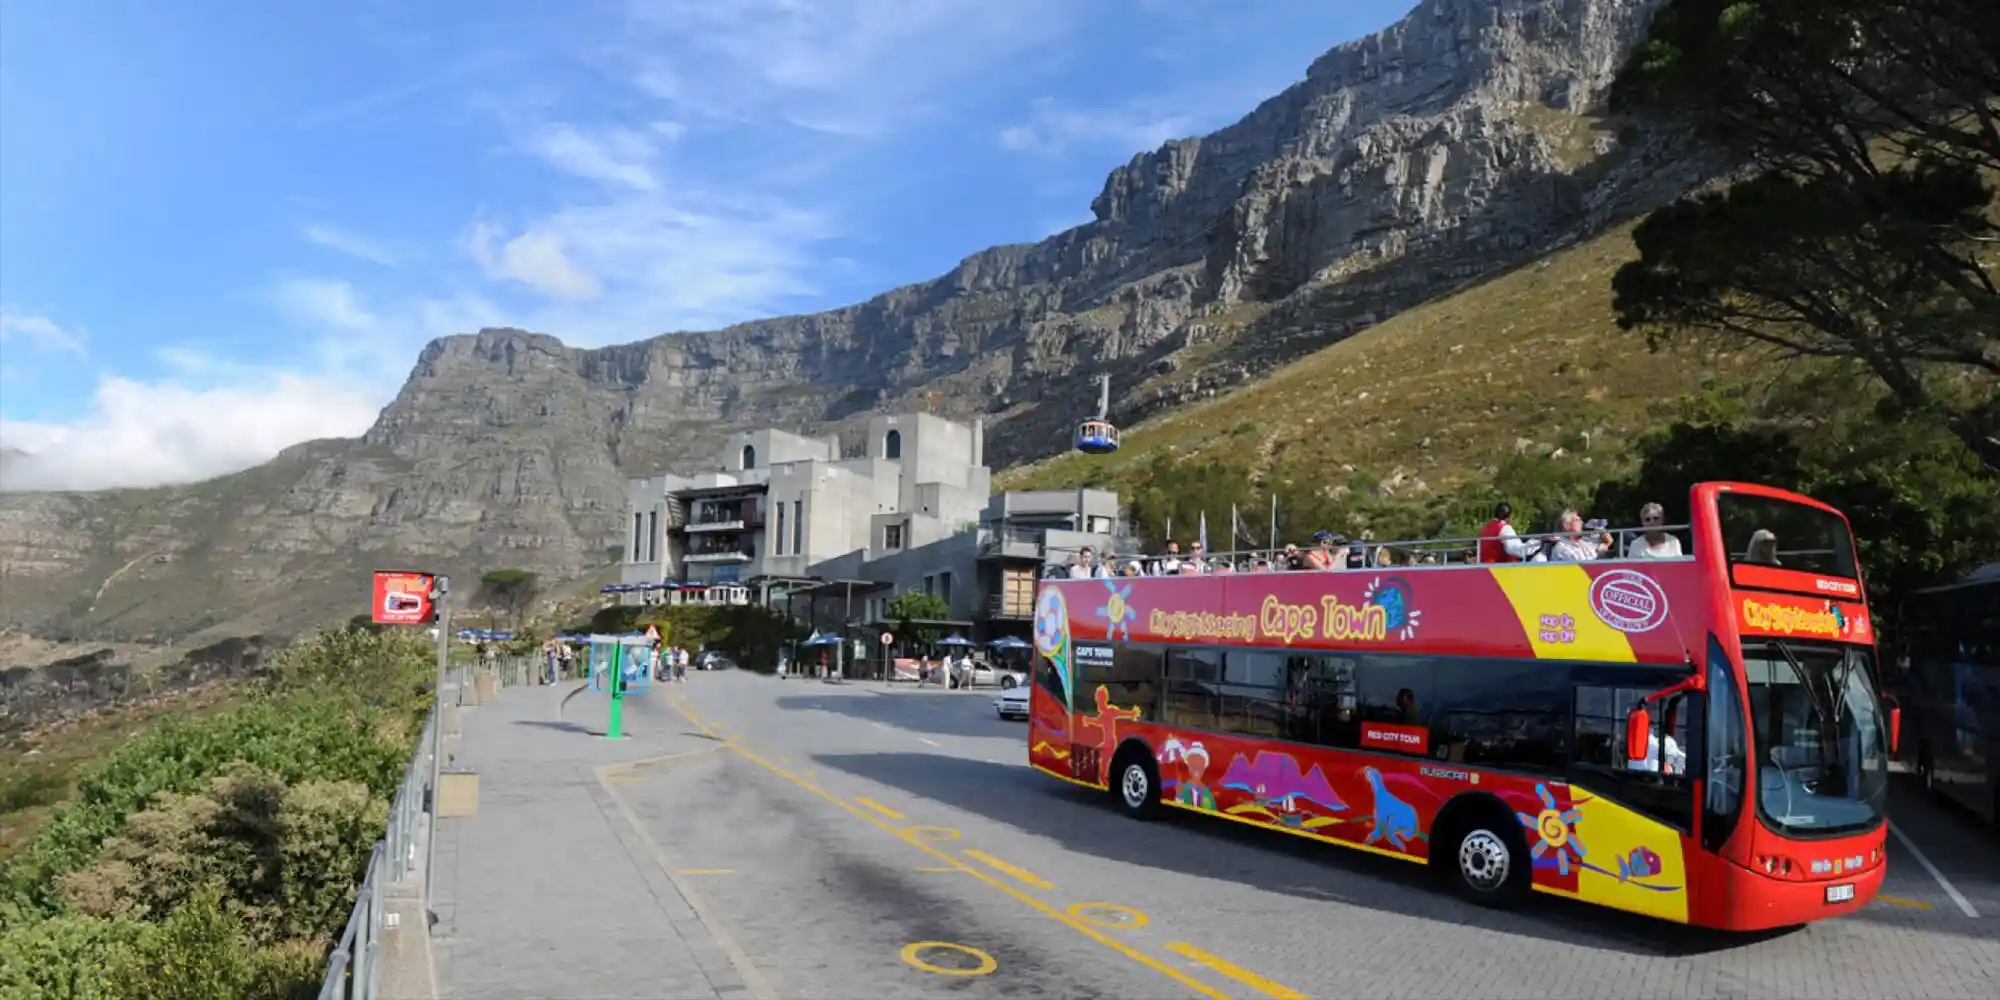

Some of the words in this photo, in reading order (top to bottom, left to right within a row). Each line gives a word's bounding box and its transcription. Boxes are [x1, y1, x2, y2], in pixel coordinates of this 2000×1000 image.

[1604, 590, 1651, 610] OFFICIAL
[1261, 594, 1316, 643] Cape
[1321, 595, 1386, 640] Town
[1367, 730, 1382, 739] RED
[1383, 732, 1398, 741] CITY
[1400, 733, 1420, 744] TOUR
